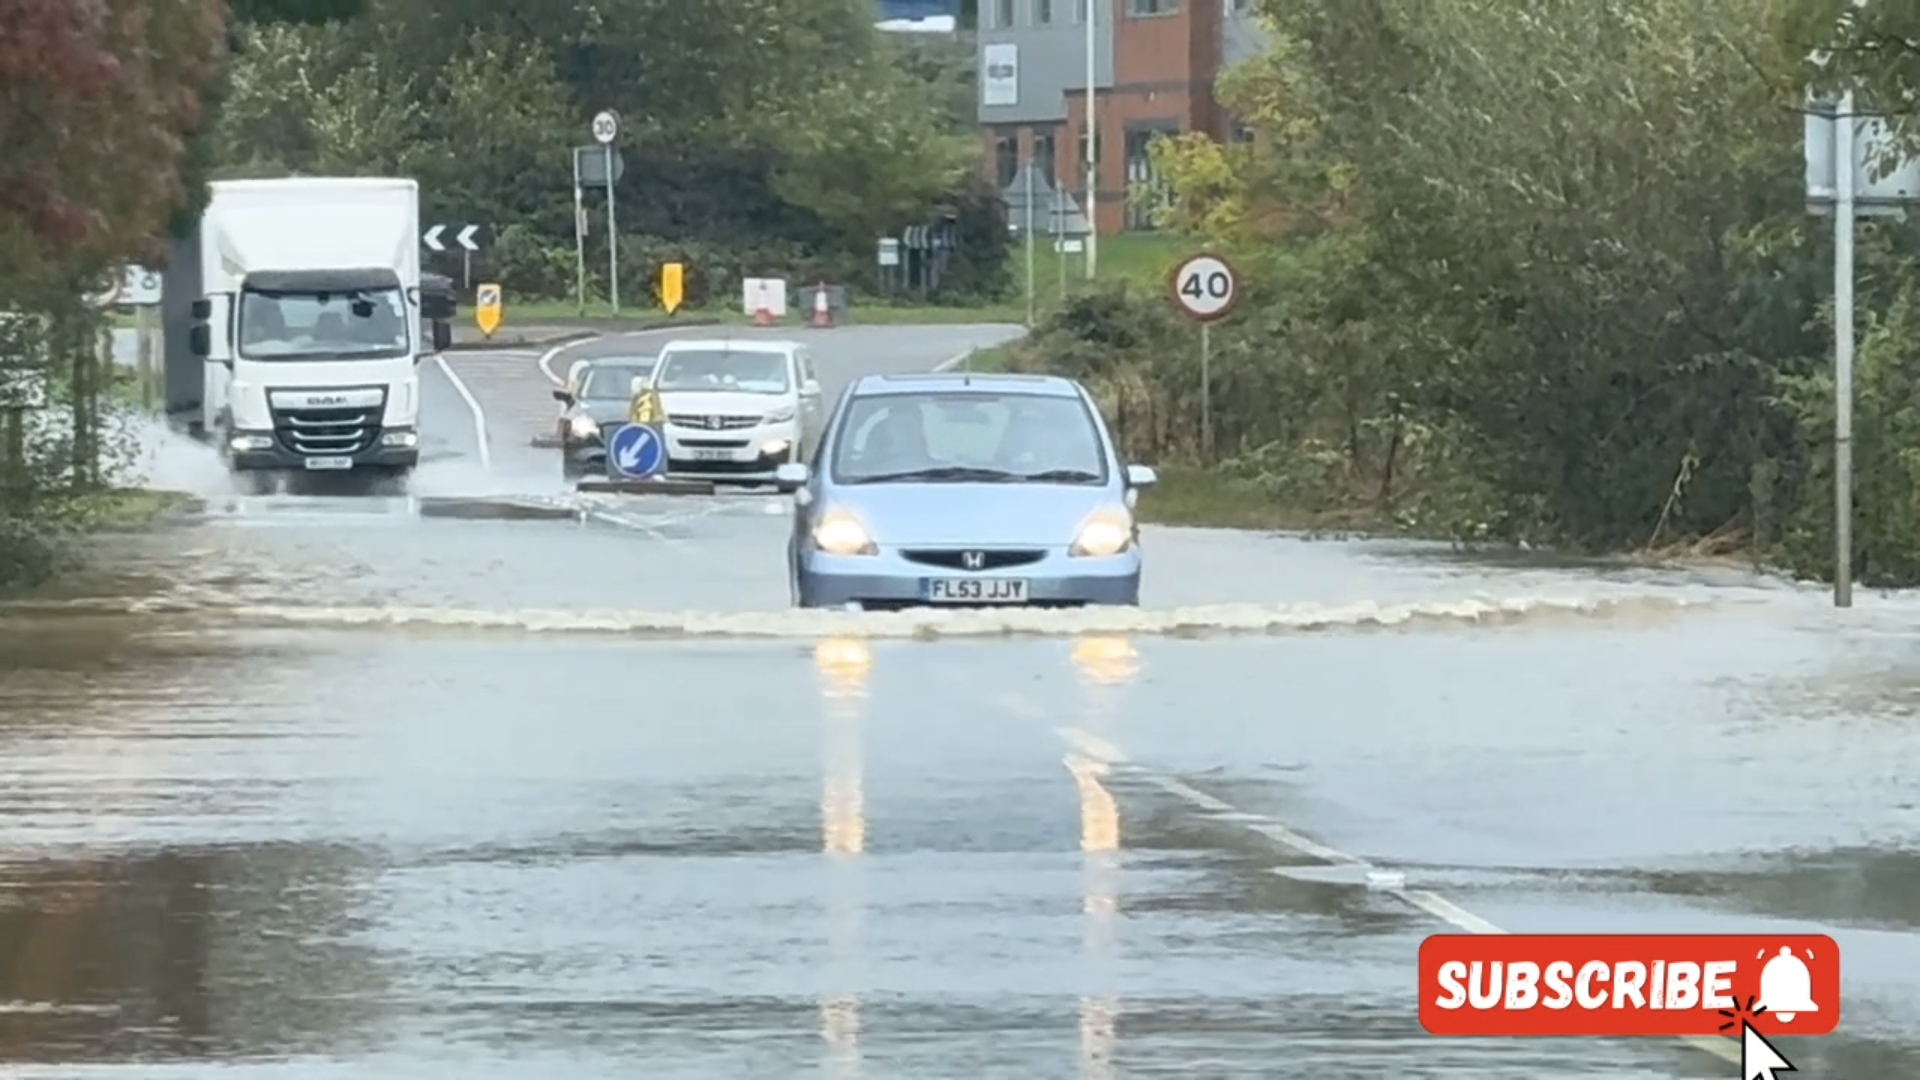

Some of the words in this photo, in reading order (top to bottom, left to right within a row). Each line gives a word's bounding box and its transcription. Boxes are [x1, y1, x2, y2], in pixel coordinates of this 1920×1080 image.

[596, 120, 613, 135] 30
[1181, 272, 1229, 299] 40
[932, 581, 982, 598] FL53
[988, 581, 1023, 598] JJY
